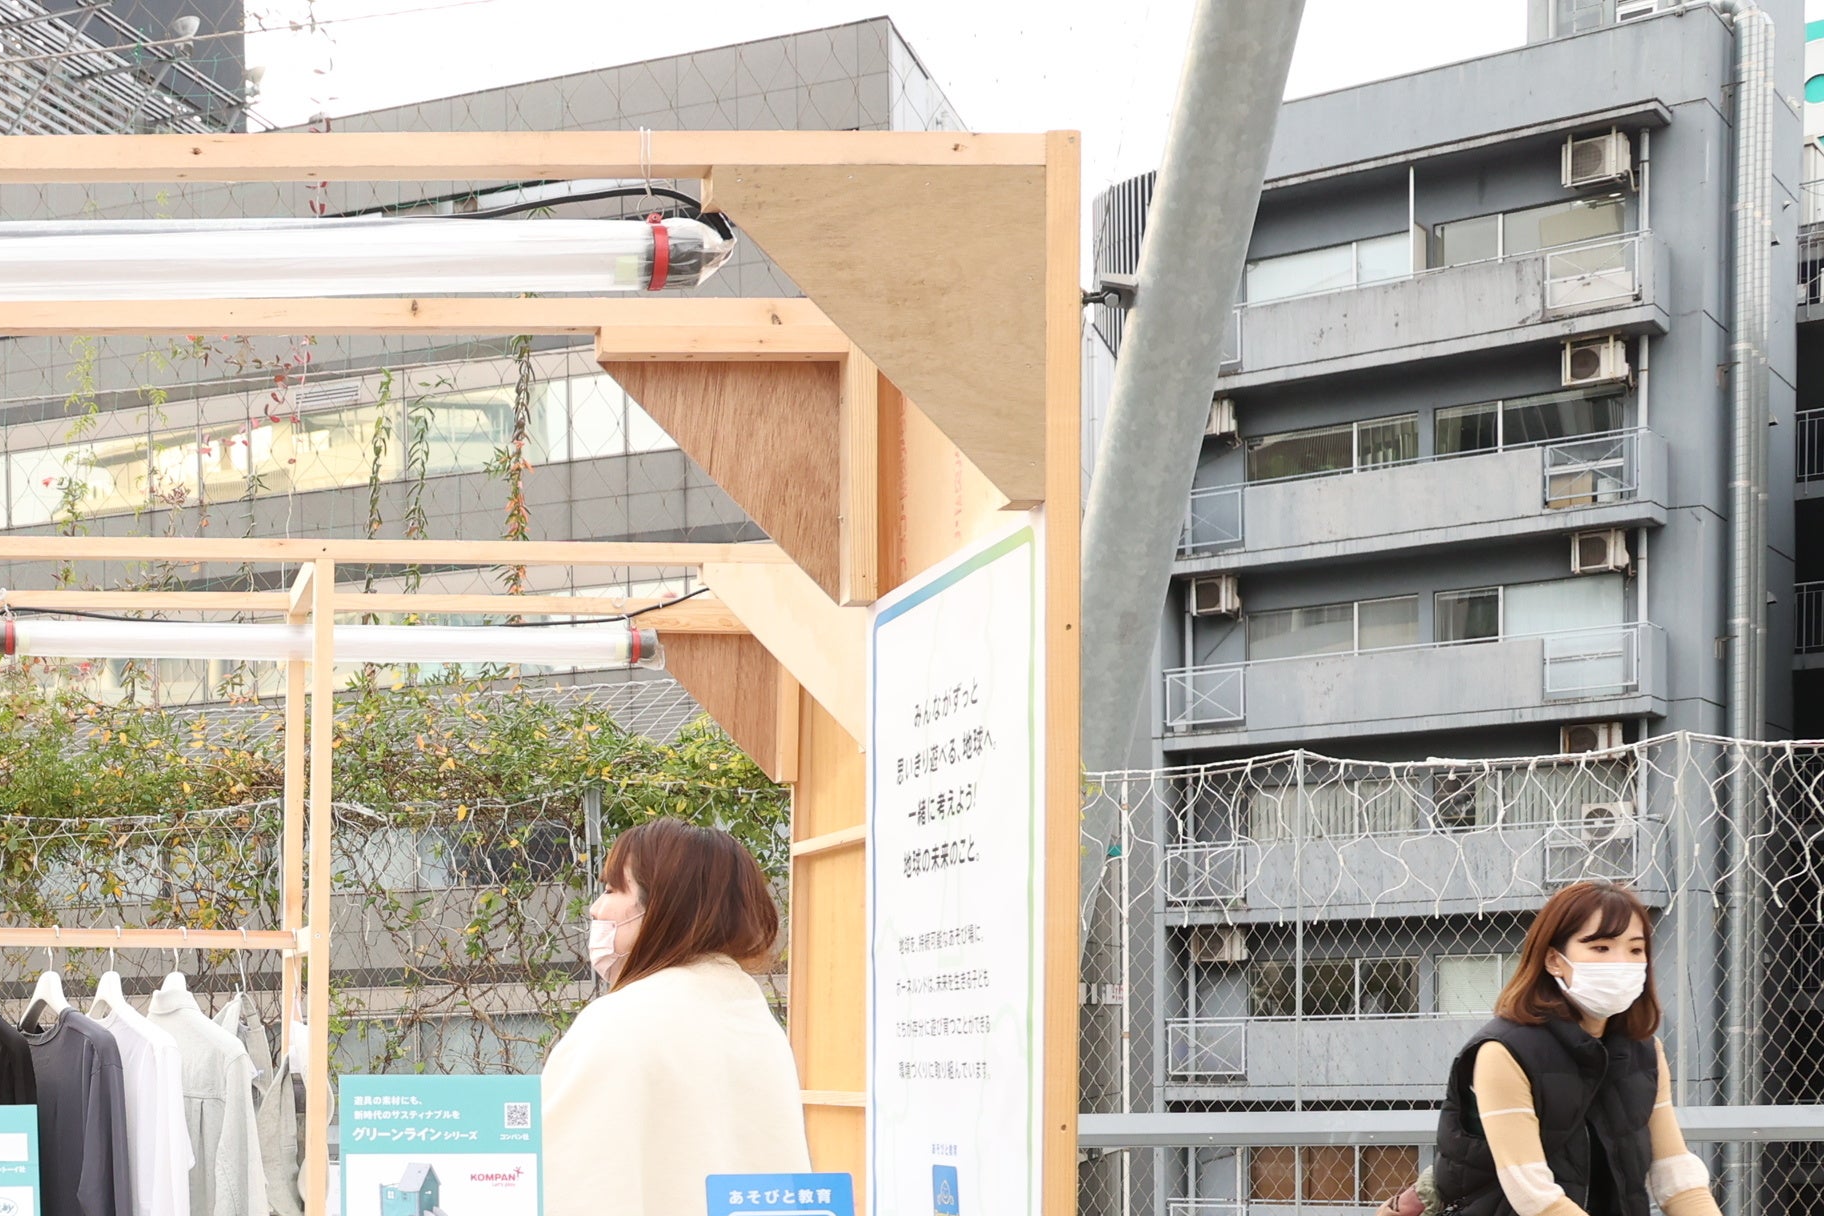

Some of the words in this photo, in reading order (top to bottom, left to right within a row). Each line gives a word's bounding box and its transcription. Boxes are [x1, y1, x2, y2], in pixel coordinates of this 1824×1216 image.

[914, 677, 978, 728] みんながずっと
[903, 834, 980, 878] 地球の未来のこと。
[353, 1096, 422, 1106] 遊具の素材にも、
[353, 1109, 460, 1120] 新時代のサスティナブルを
[352, 1127, 441, 1141] グリーンライン
[444, 1130, 477, 1140] シリーズ
[470, 1173, 516, 1182] KOMPAN
[728, 1188, 832, 1205] あそびと教育
